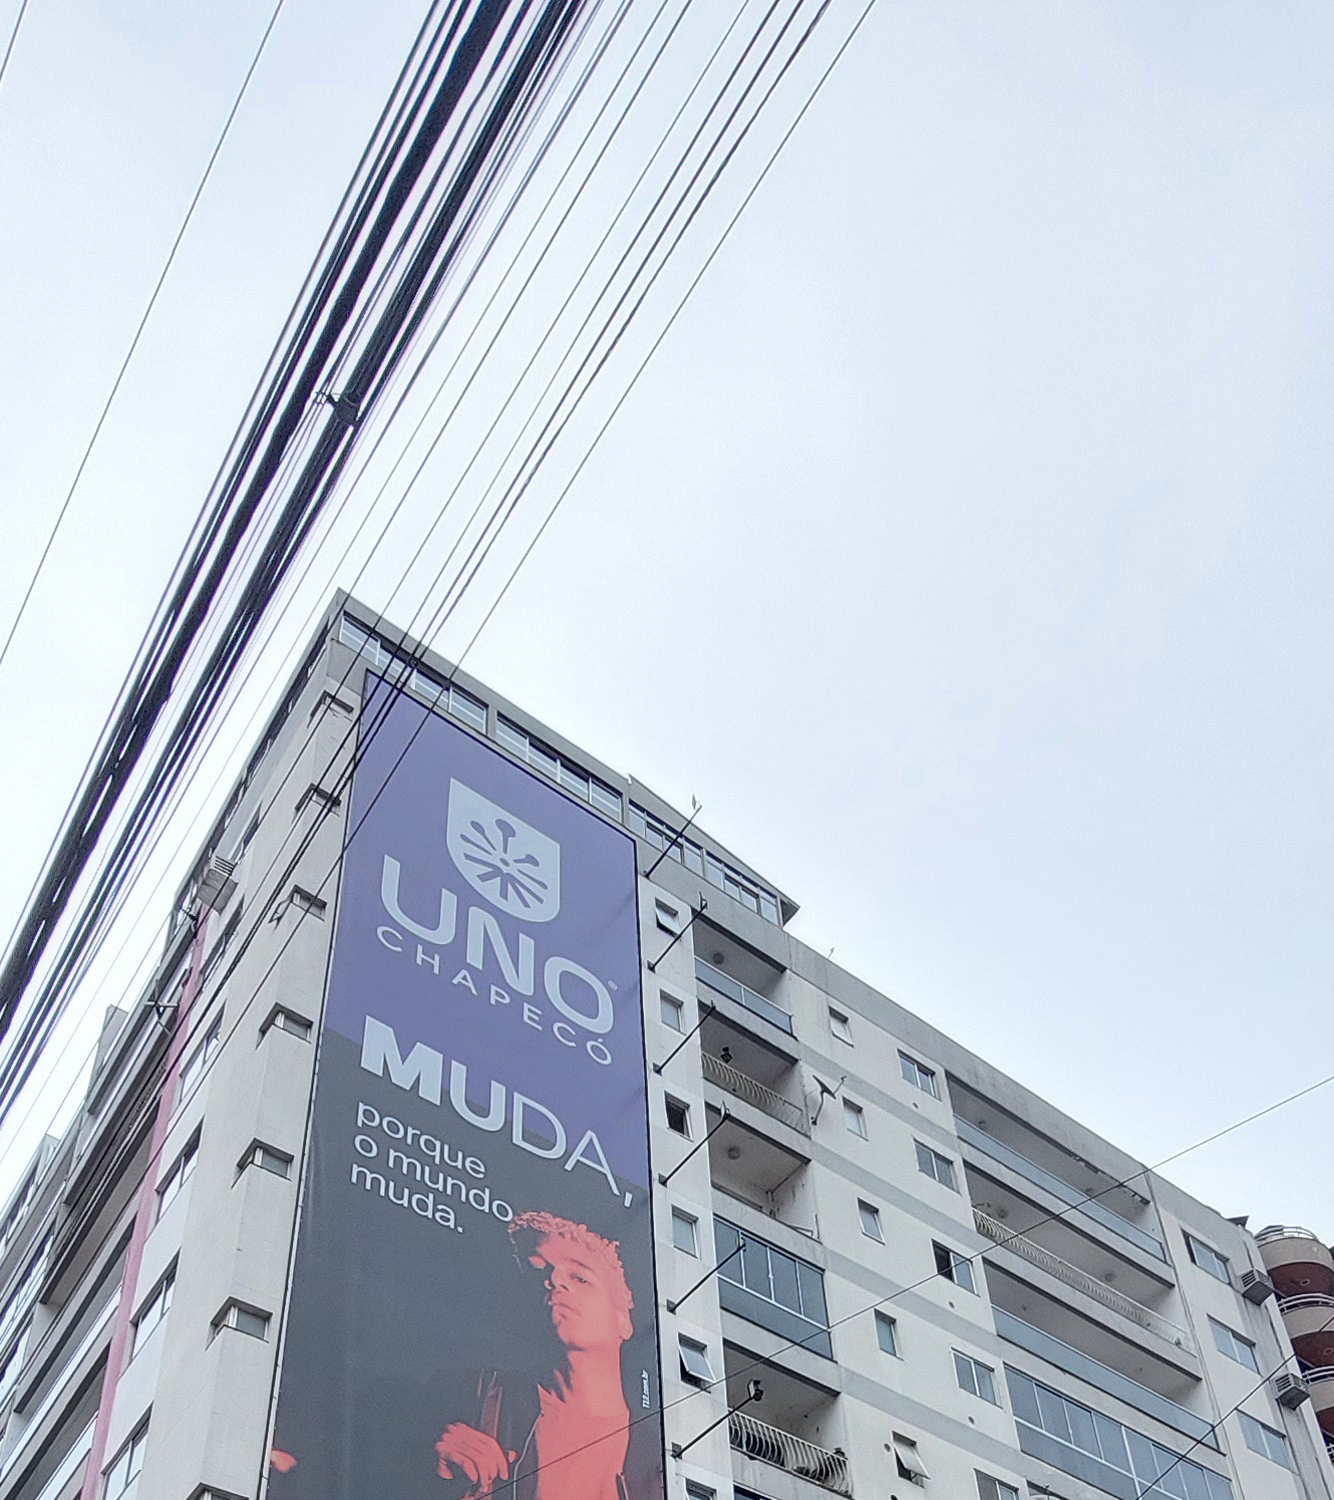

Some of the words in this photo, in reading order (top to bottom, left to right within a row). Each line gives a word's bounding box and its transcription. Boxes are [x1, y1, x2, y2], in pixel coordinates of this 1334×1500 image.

[376, 925, 612, 1066] CHAPECÓ
[380, 854, 615, 1035] UNO
[355, 1101, 485, 1179] porque
[360, 1014, 633, 1208] MUDA,
[350, 1163, 465, 1234] muda.
[354, 1135, 378, 1159] o
[387, 1147, 514, 1223] mundo
